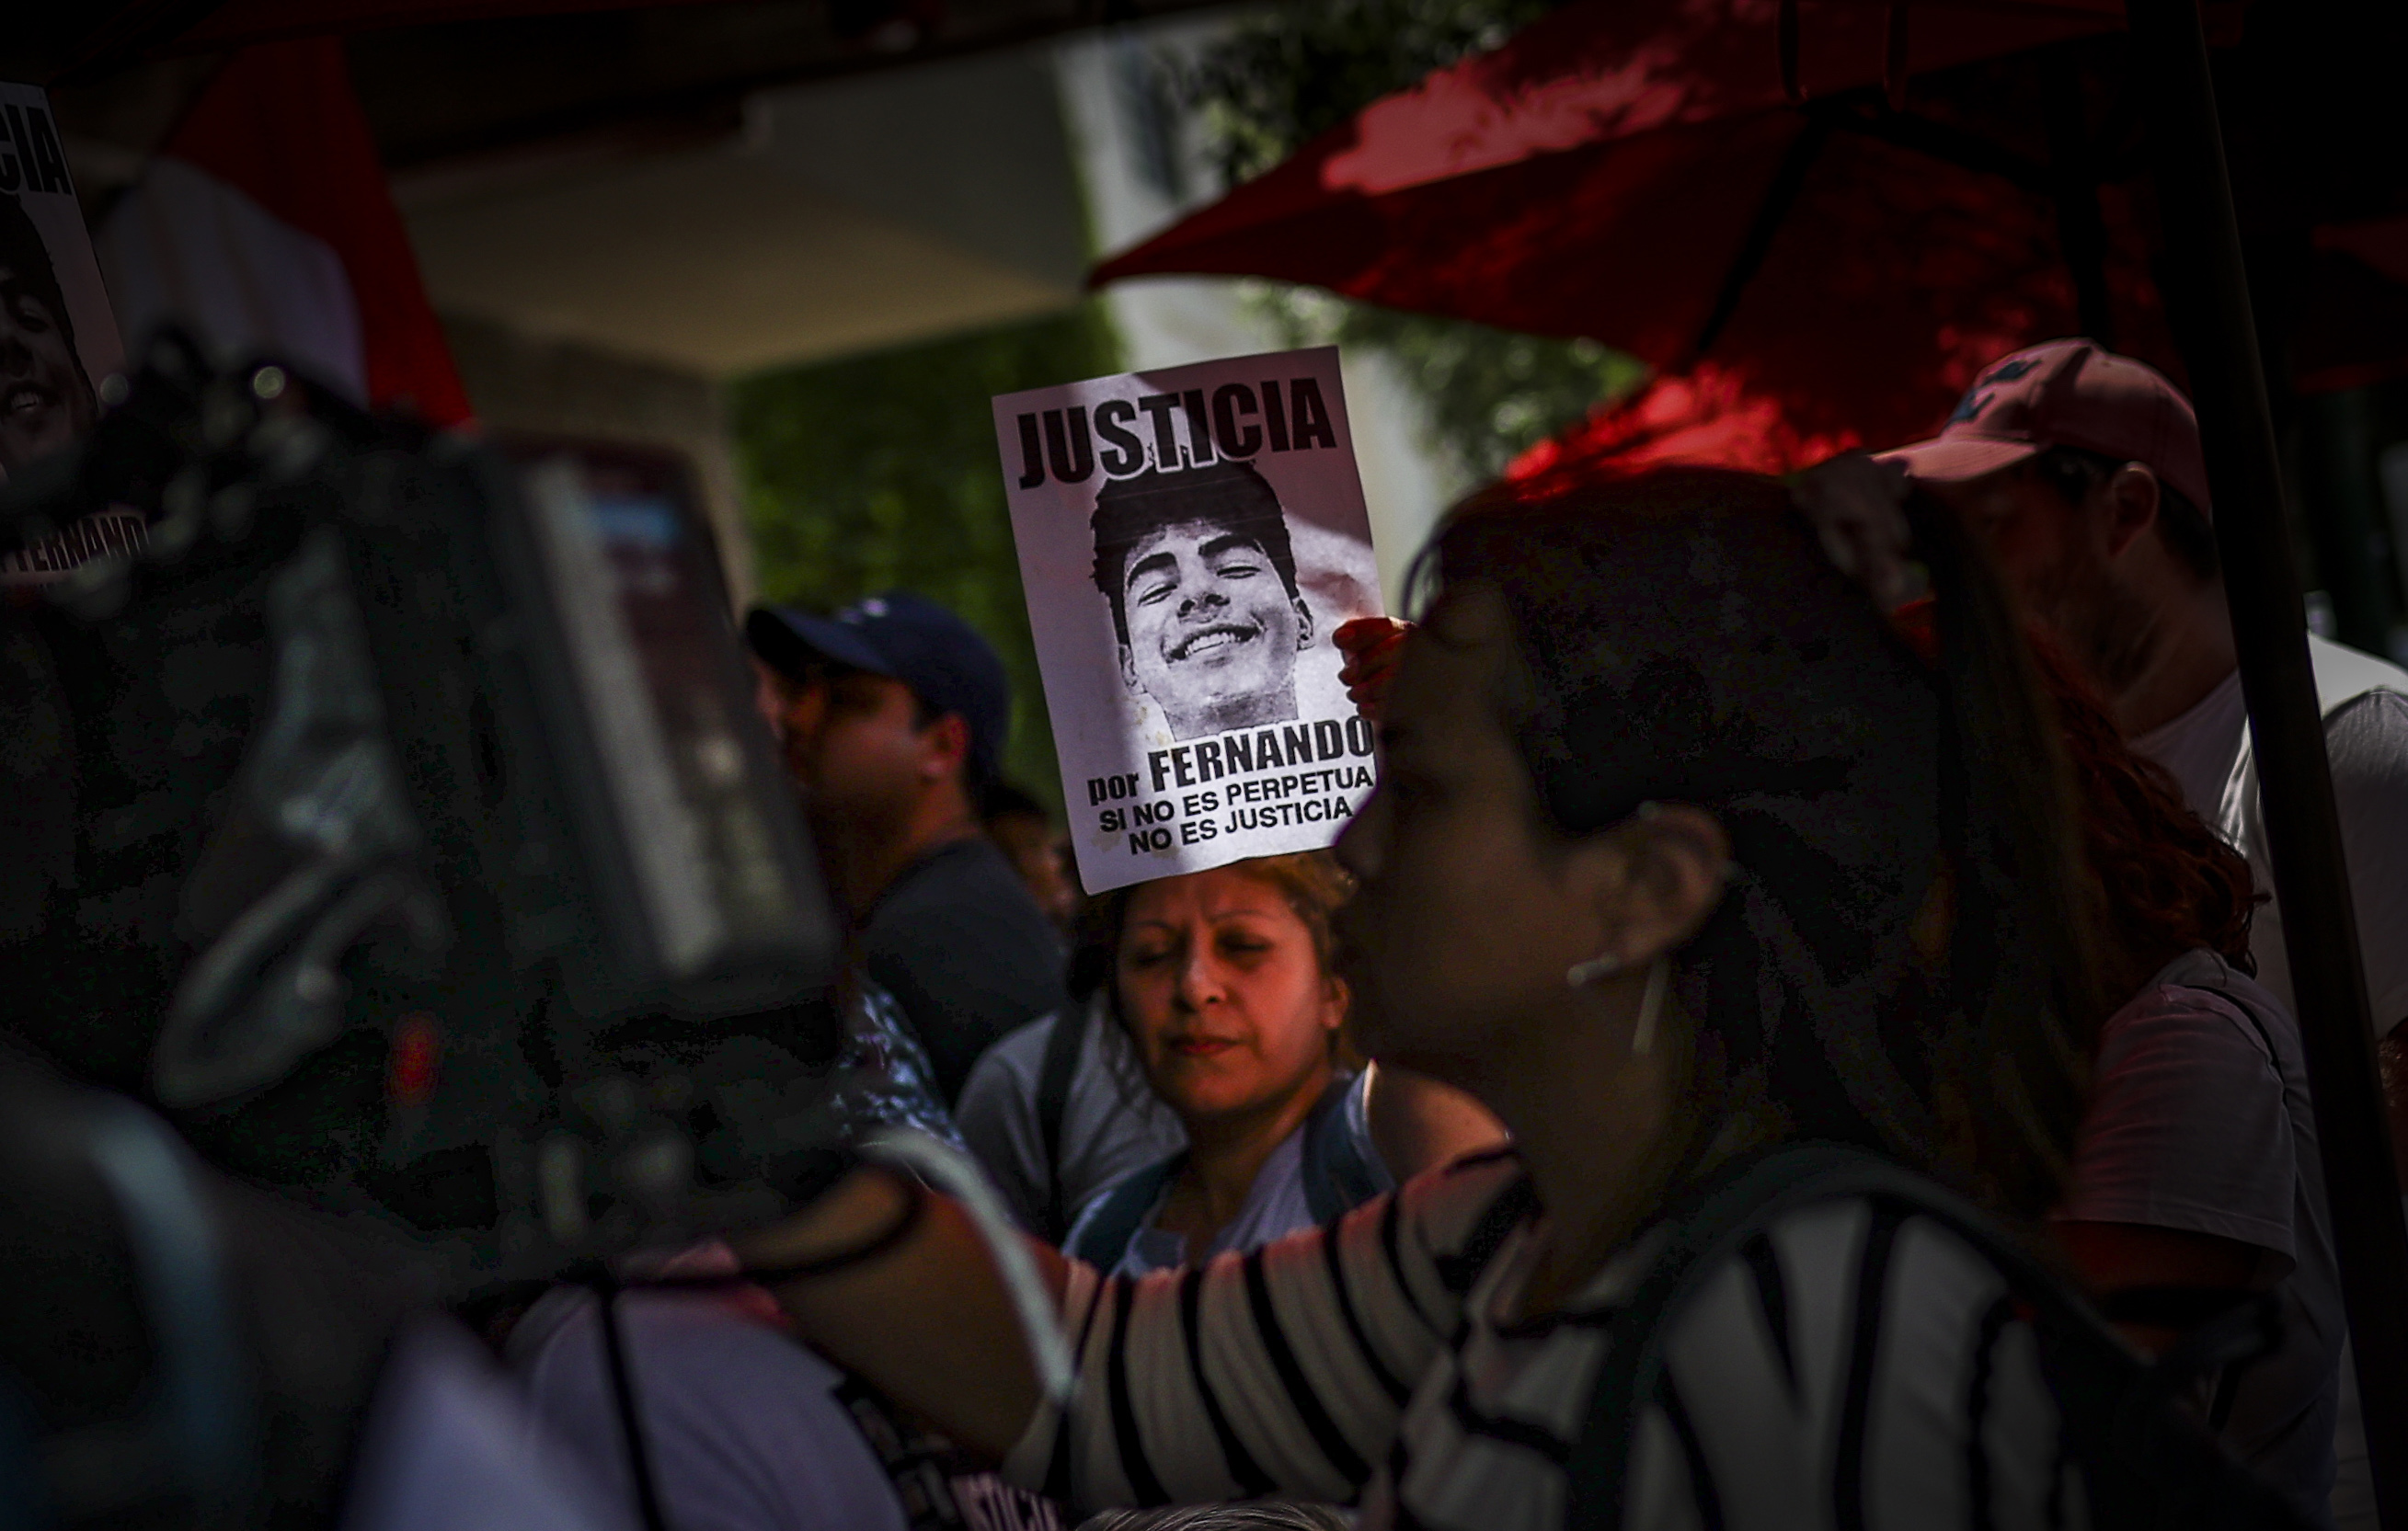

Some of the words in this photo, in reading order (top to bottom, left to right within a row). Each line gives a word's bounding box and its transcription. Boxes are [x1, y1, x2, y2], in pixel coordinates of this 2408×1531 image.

[1017, 378, 1336, 490] JUSTICIA
[1086, 772, 1140, 806] por
[1148, 714, 1374, 793] FERNANDO
[1099, 807, 1128, 834] SI
[1133, 800, 1175, 827] NO
[1182, 791, 1220, 817] ES
[1225, 765, 1374, 806] PERPETUA
[1129, 828, 1173, 856] NO
[1180, 818, 1218, 846] ES
[1224, 795, 1353, 835] JUSTICIA
